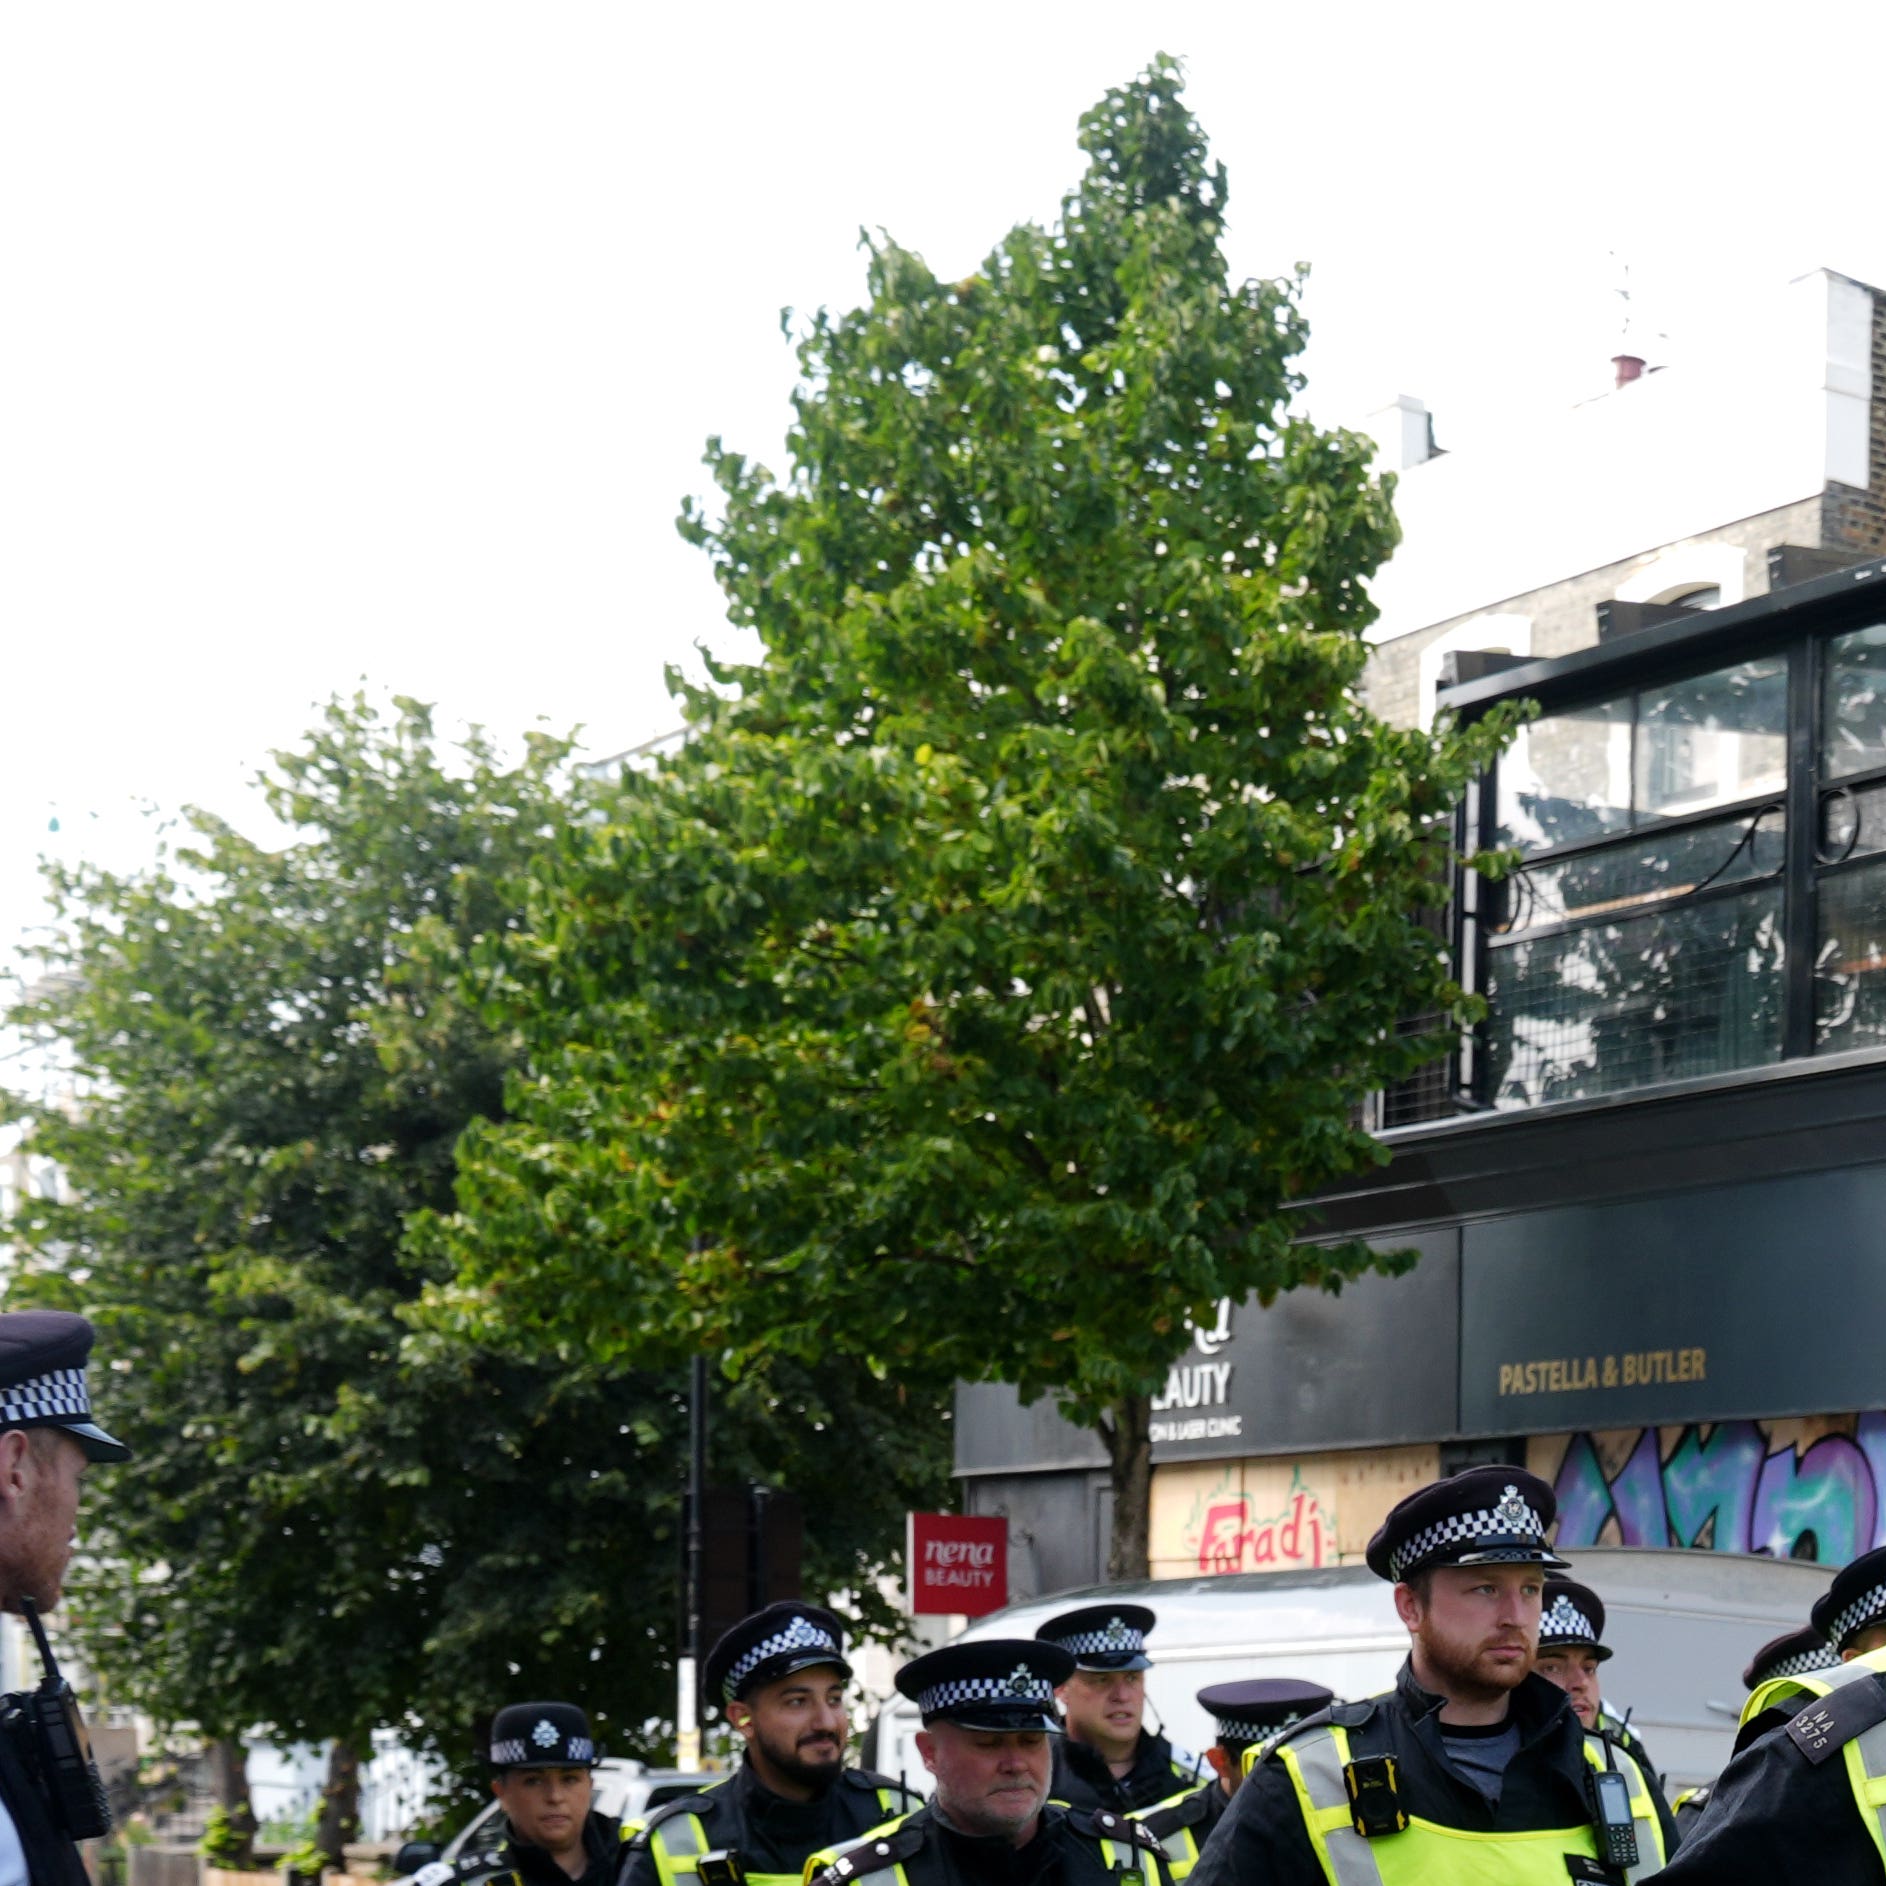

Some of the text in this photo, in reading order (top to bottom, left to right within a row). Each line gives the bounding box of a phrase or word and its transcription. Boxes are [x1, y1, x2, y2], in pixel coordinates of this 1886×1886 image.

[1152, 1361, 1231, 1410] AUTY
[1499, 1347, 1707, 1396] PASTELLA & BUTLER
[925, 1538, 995, 1568] nena
[924, 1568, 994, 1588] BEAUTY
[1796, 1715, 1828, 1749] 3275
[1812, 1709, 1835, 1733] NA
